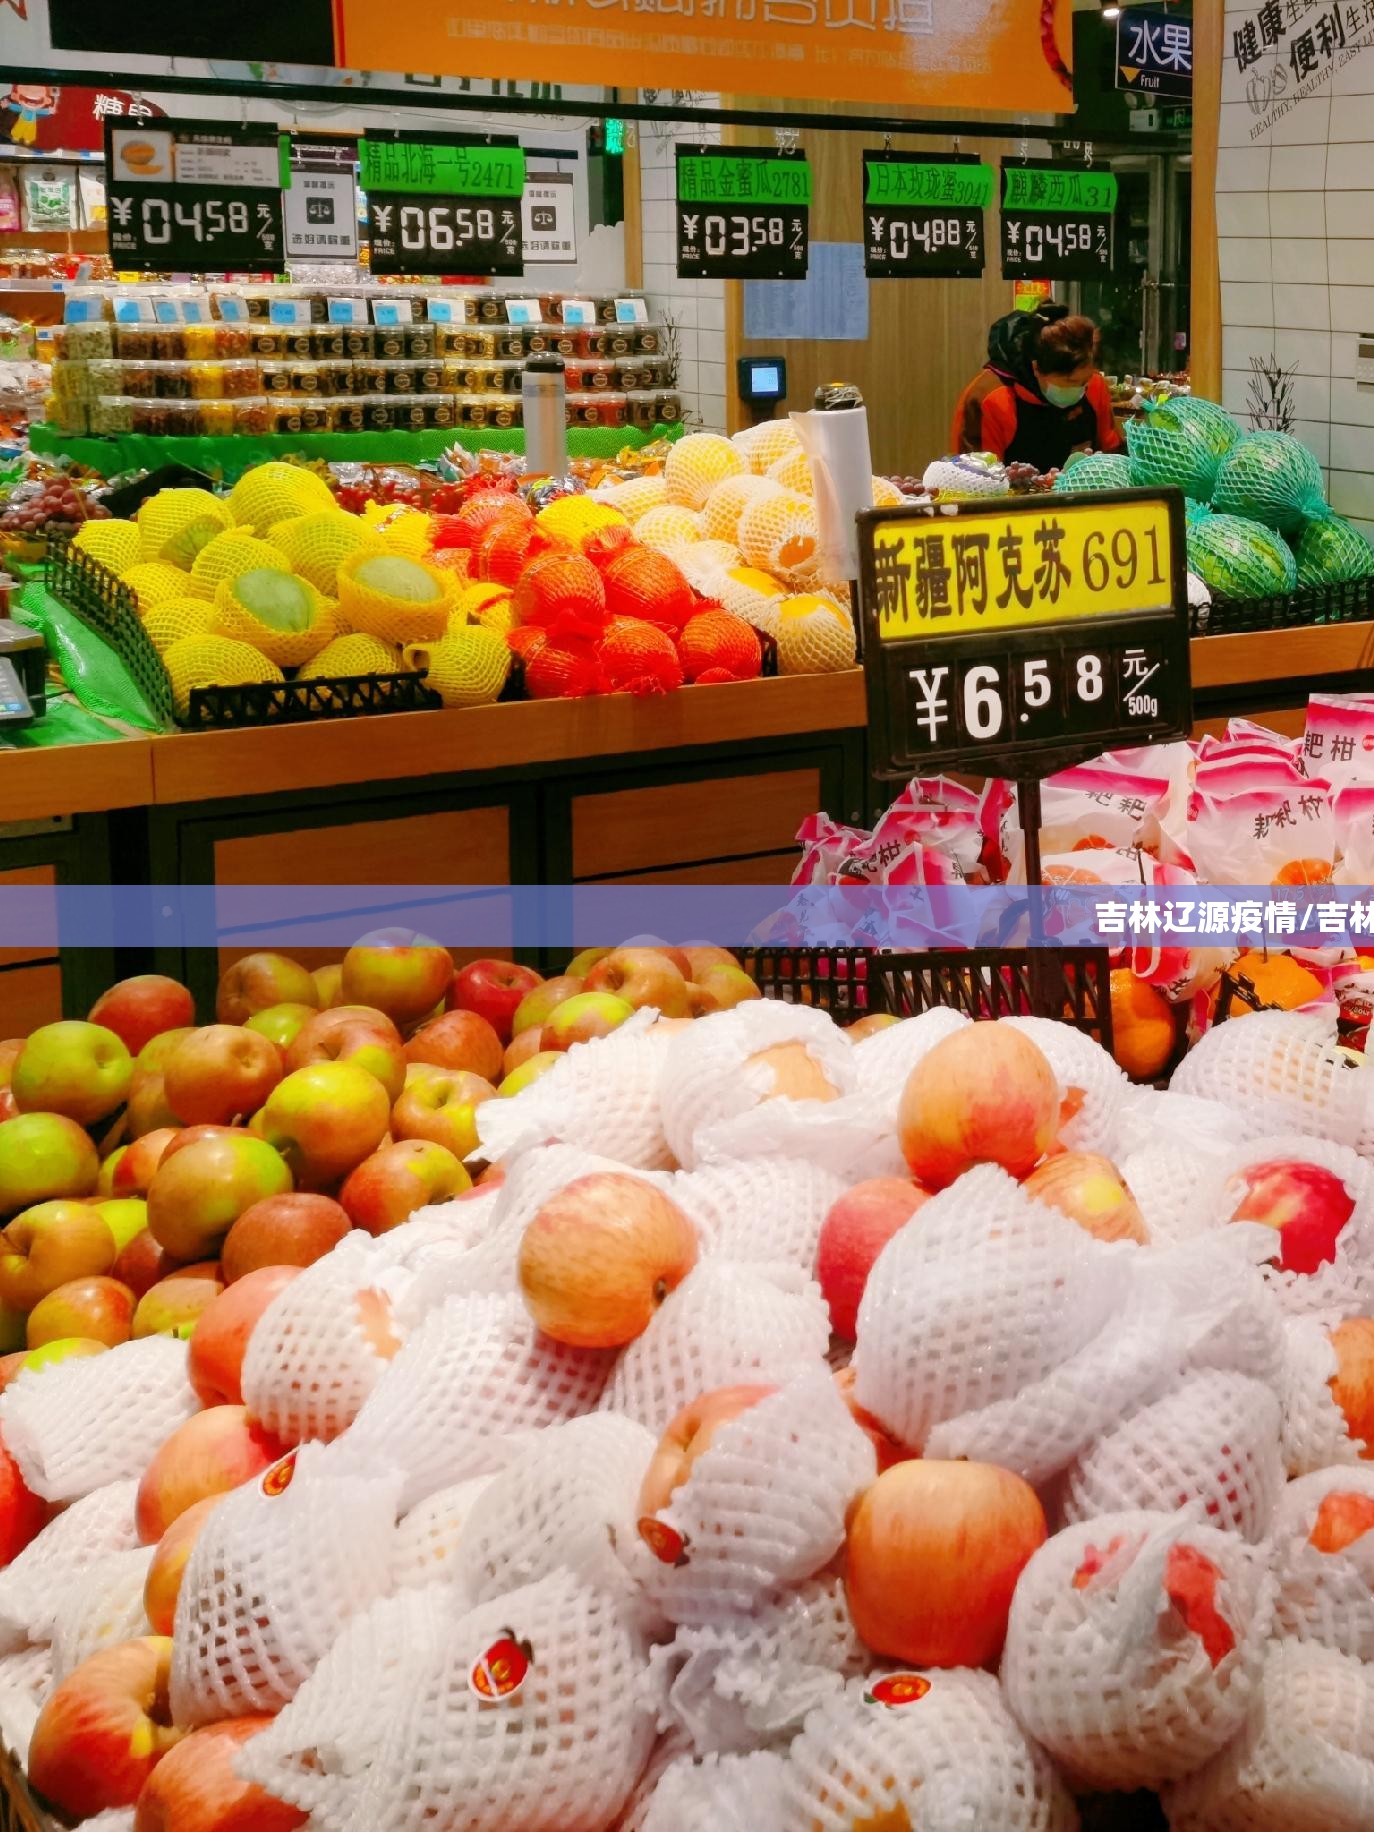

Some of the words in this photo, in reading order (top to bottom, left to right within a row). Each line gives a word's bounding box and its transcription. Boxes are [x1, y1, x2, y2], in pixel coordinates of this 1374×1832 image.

[1127, 19, 1192, 71] 水果
[1140, 73, 1160, 88] Fruit
[365, 140, 515, 190] 精品北海一号2471
[681, 159, 811, 199] 精品金蜜瓜2781
